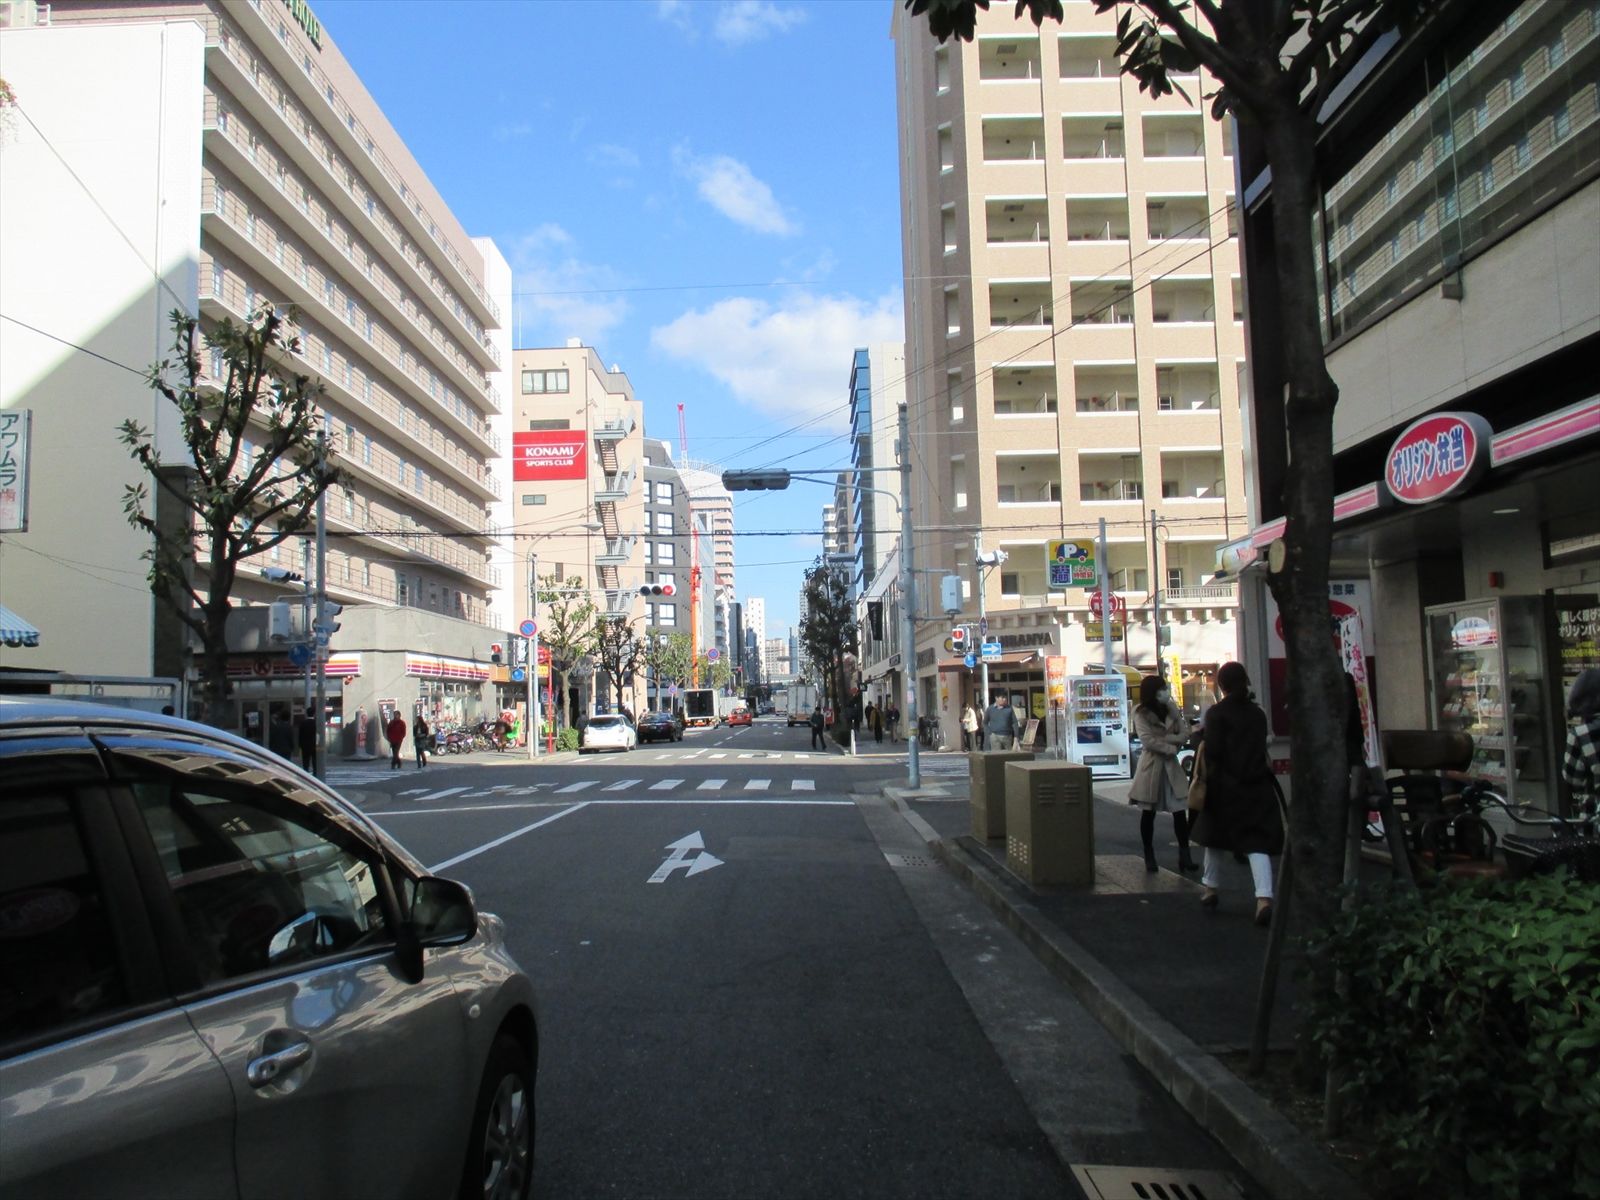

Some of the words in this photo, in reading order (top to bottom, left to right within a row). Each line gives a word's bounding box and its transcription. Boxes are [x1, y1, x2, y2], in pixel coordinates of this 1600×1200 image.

[525, 446, 574, 457] KONAMI
[1392, 424, 1467, 492] オリジン弁当
[526, 459, 554, 467] SPORTS
[1064, 543, 1078, 558] P
[1327, 583, 1356, 596] 惣菜
